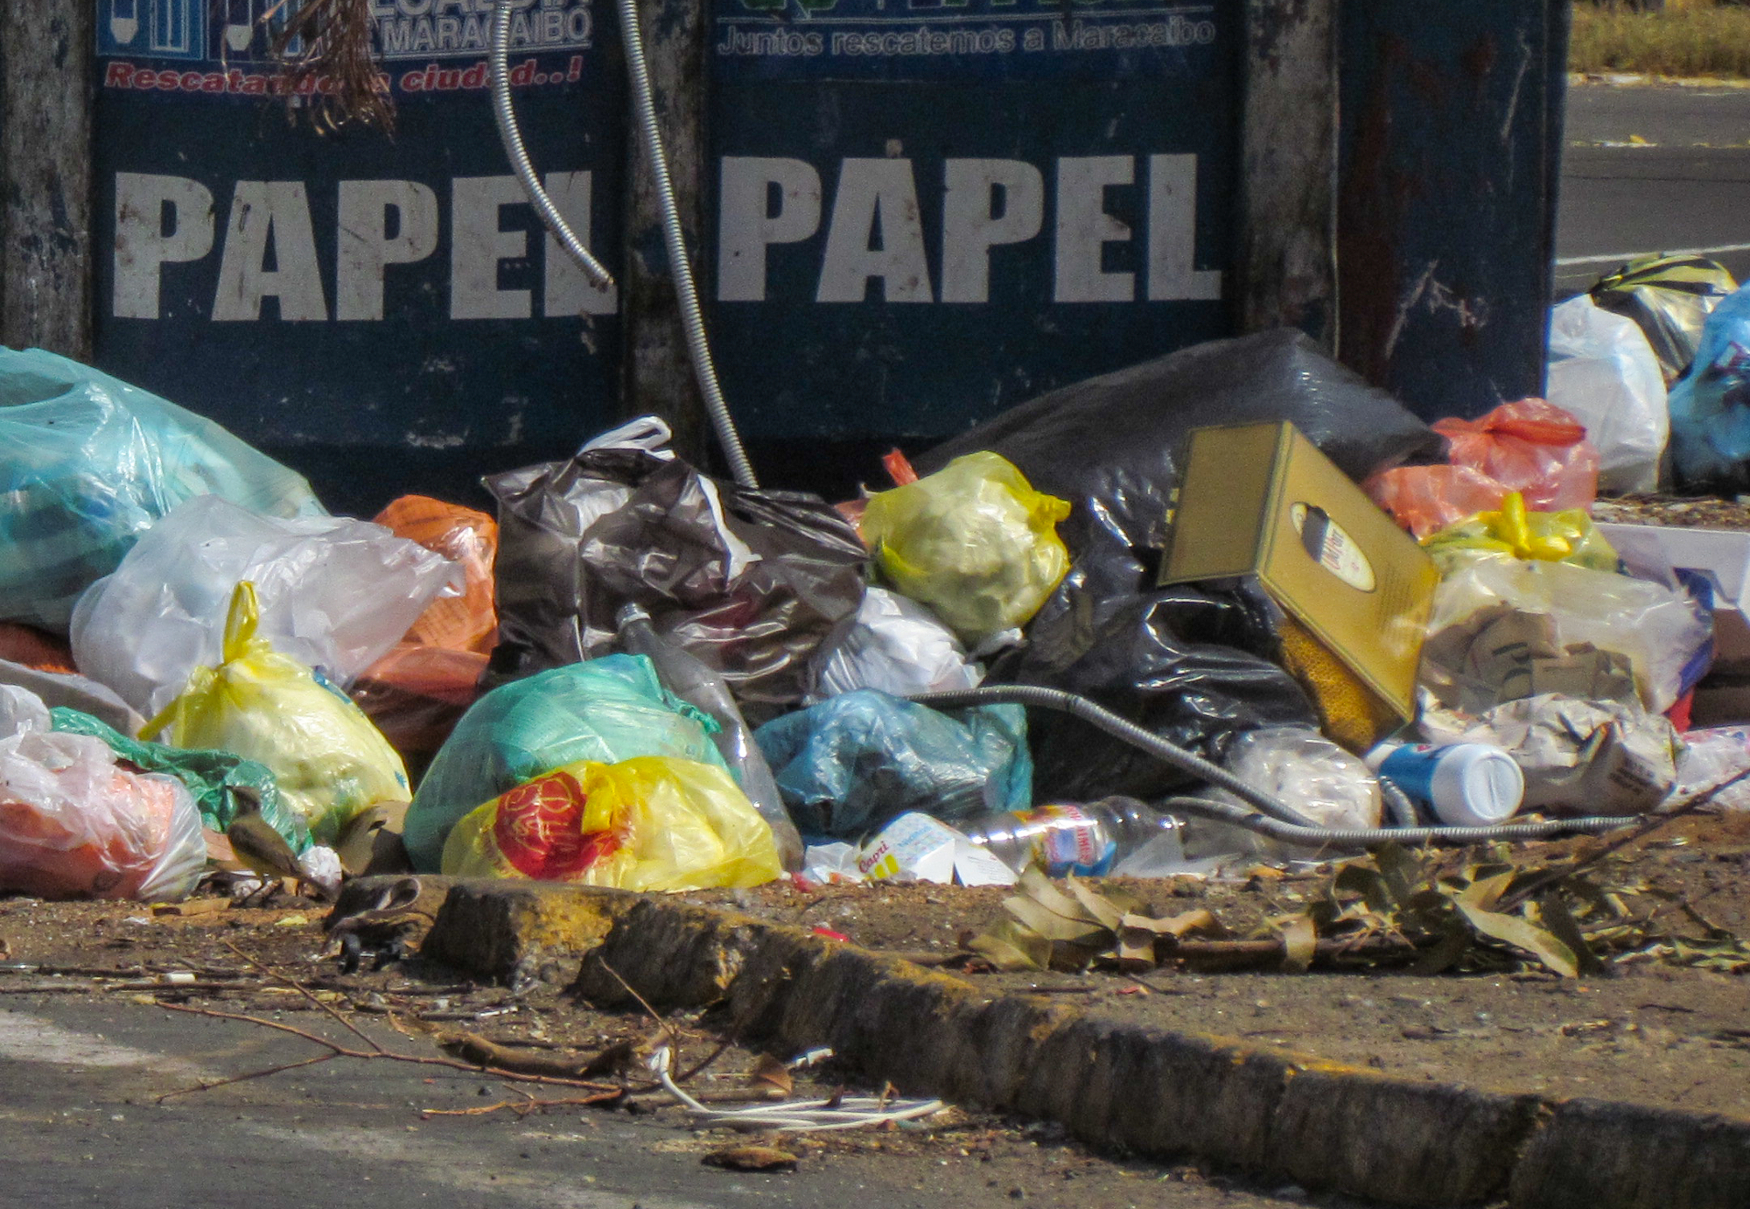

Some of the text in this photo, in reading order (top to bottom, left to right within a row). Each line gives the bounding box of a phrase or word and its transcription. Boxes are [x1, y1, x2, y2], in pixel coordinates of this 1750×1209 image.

[718, 16, 1217, 56] Juntos rescatemos a Maracaibo
[400, 55, 583, 92] ciudd..!
[112, 171, 619, 322] PAPEL
[716, 153, 1224, 305] PAPEL
[858, 840, 890, 874] Capri
